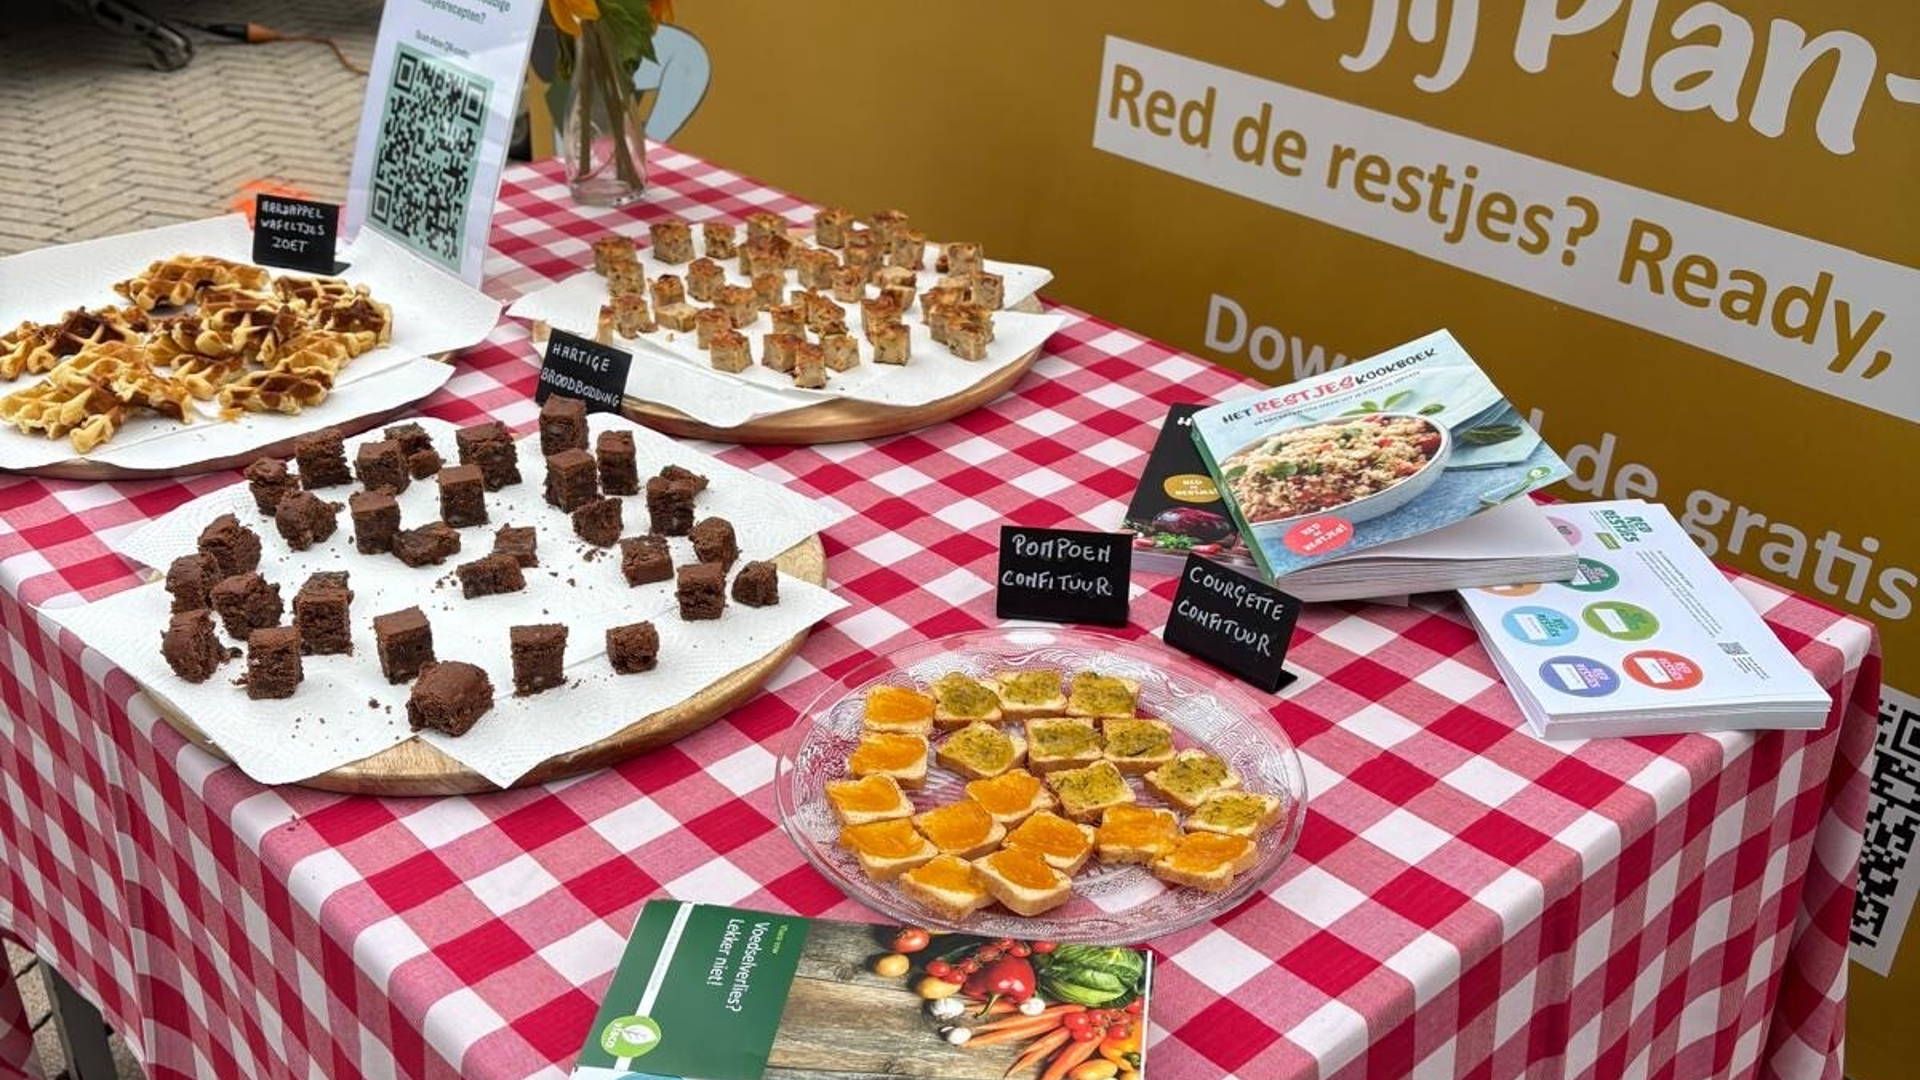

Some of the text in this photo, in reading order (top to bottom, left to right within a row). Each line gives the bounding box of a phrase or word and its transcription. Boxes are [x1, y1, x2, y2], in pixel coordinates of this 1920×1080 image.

[270, 236, 309, 254] ZOET
[1109, 63, 1893, 380] Red de restjes? Ready,
[551, 342, 612, 373] HARTIGE
[1221, 409, 1252, 425] HET
[1011, 533, 1112, 564] POMPOEN
[1564, 431, 1660, 500] de
[1679, 488, 1919, 621] gratis
[1001, 570, 1113, 597] CONFITUUR
[1188, 565, 1286, 622] COURGETTE
[1176, 598, 1272, 657] CONFITUUR
[706, 918, 745, 987] Lekker niet!
[725, 921, 771, 1012] Voedselverlies?
